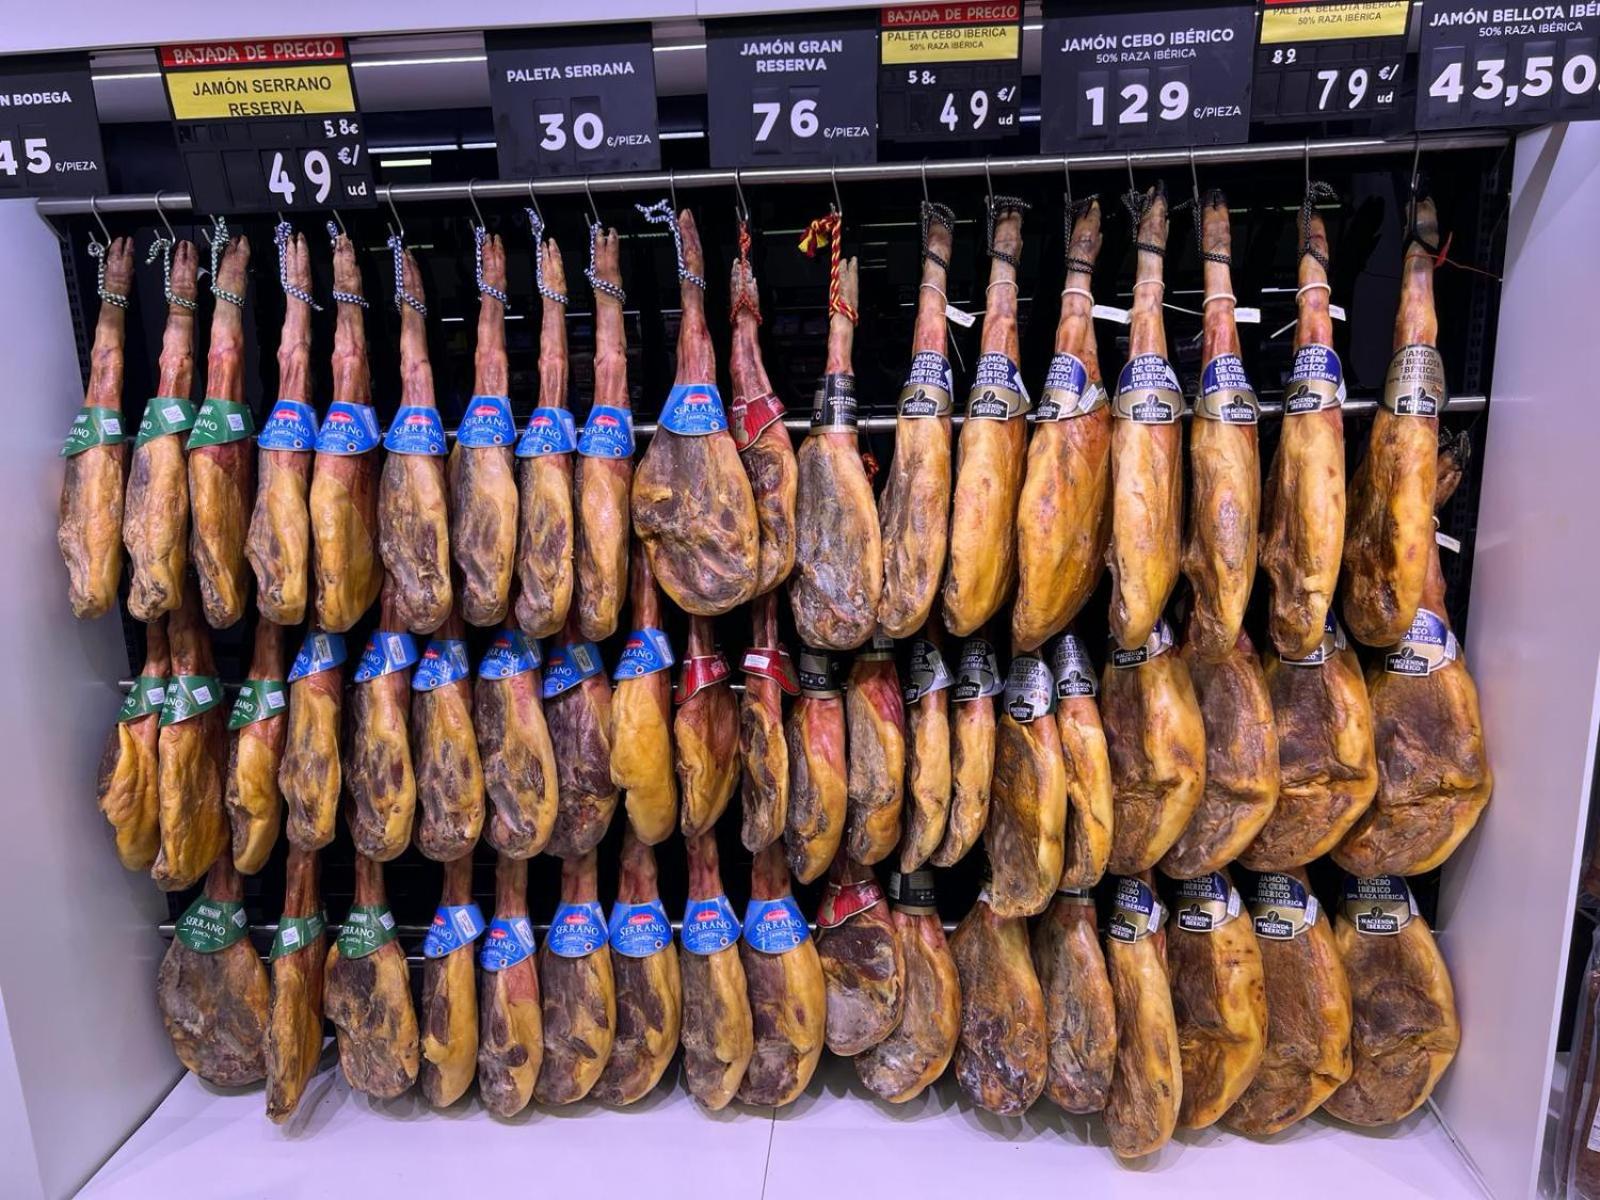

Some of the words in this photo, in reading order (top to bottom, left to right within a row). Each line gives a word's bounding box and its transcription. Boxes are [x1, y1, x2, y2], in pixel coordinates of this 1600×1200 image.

[888, 9, 940, 23] BAJADA
[945, 8, 963, 20] DE
[967, 5, 1017, 18] PRECIO
[1298, 17, 1316, 25] 50%
[1318, 14, 1342, 23] RAZA
[1430, 9, 1488, 27] JAMÓN
[1493, 5, 1565, 22] BELLOTA
[887, 31, 928, 41] PALETA
[931, 29, 960, 39] CEBO
[1479, 27, 1502, 37] 50%
[1505, 25, 1535, 36] RAZA
[1539, 21, 1583, 33] IBÉRICA
[740, 38, 795, 56] JAMÓN
[798, 40, 843, 54] GRAN
[909, 43, 925, 51] 50%
[927, 41, 949, 50] RAZA
[1061, 34, 1118, 53] JAMÓN
[1121, 33, 1166, 49] CEBO
[1169, 27, 1235, 45] IBÉRICO
[174, 47, 239, 65] BAJADA
[246, 45, 268, 61] DE
[274, 40, 337, 59] PRECIO
[1096, 53, 1119, 64] 50%
[1121, 51, 1151, 62] RAZA
[1153, 47, 1197, 60] IBÉRICA
[507, 67, 562, 83] PALETA
[564, 61, 635, 79] SERRANA
[756, 58, 828, 73] RESERVA
[192, 76, 248, 97] JAMÓN
[252, 76, 332, 94] SERRANO
[1316, 68, 1369, 110] 79
[13, 91, 72, 106] BODEGA
[1085, 80, 1190, 127] 129
[1193, 105, 1242, 119] €/PIEZA
[1376, 91, 1393, 104] ud
[228, 100, 306, 117] RESERVA
[939, 90, 988, 131] 49
[752, 99, 820, 142] 76
[823, 126, 870, 139] €/PIEZA
[998, 114, 1013, 126] ud
[539, 112, 604, 151] 30
[607, 134, 652, 148] €/PIEZA
[0, 138, 52, 176] 45
[54, 160, 98, 173] €/PIEZA
[268, 150, 332, 204] 49
[347, 181, 368, 196] ud
